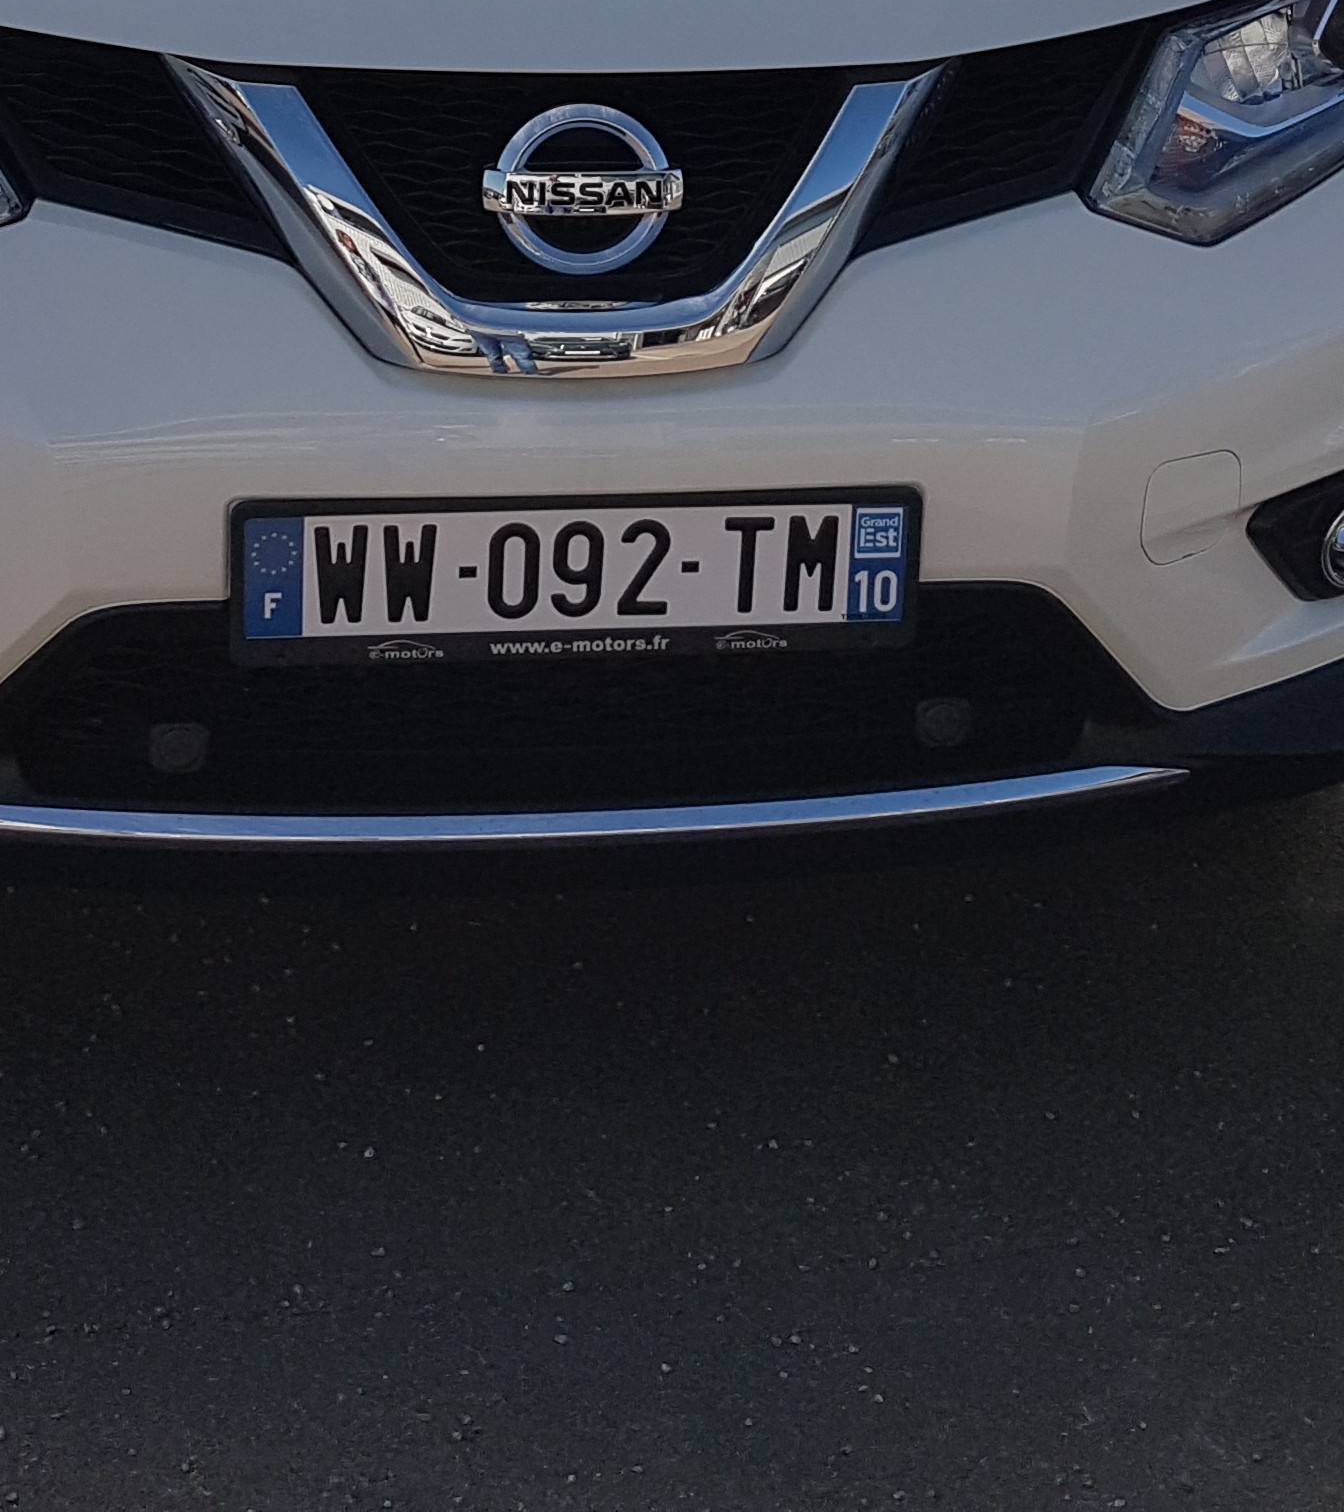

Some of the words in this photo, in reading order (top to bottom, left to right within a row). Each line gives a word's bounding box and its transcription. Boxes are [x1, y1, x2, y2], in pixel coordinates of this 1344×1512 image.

[505, 180, 664, 207] NISSAN
[860, 516, 899, 527] Grand
[859, 528, 898, 547] Est
[854, 570, 898, 612] 10
[264, 592, 283, 619] F
[490, 636, 670, 655] www.e-motors.fr
